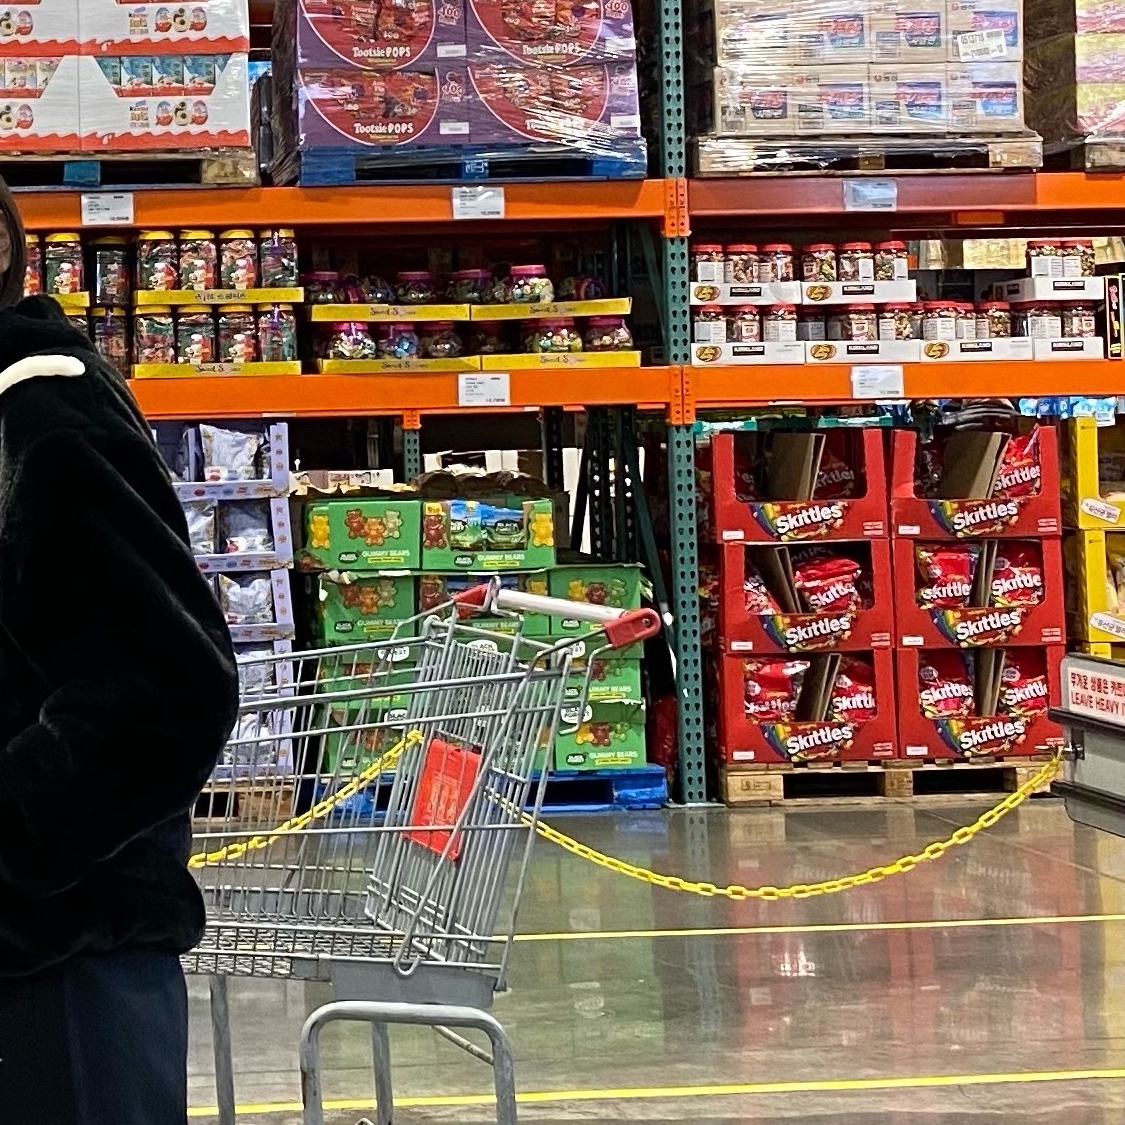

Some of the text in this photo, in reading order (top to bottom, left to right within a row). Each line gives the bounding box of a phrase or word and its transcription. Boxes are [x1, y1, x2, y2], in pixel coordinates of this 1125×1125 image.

[352, 46, 411, 58] Tootsie POPS
[353, 123, 414, 134] Tootsie POPS
[776, 504, 843, 534] Skittles
[953, 501, 1018, 531] Skittles
[992, 574, 1042, 596] Skittle
[785, 617, 852, 645] Skittles
[956, 611, 1021, 640] Skittles
[1071, 672, 1125, 697] 무거운 상품은 카트
[1071, 690, 1094, 709] LEAVE
[1095, 696, 1119, 715] HEAVY
[786, 726, 853, 754] Skittles
[960, 720, 1026, 749] Skittles
